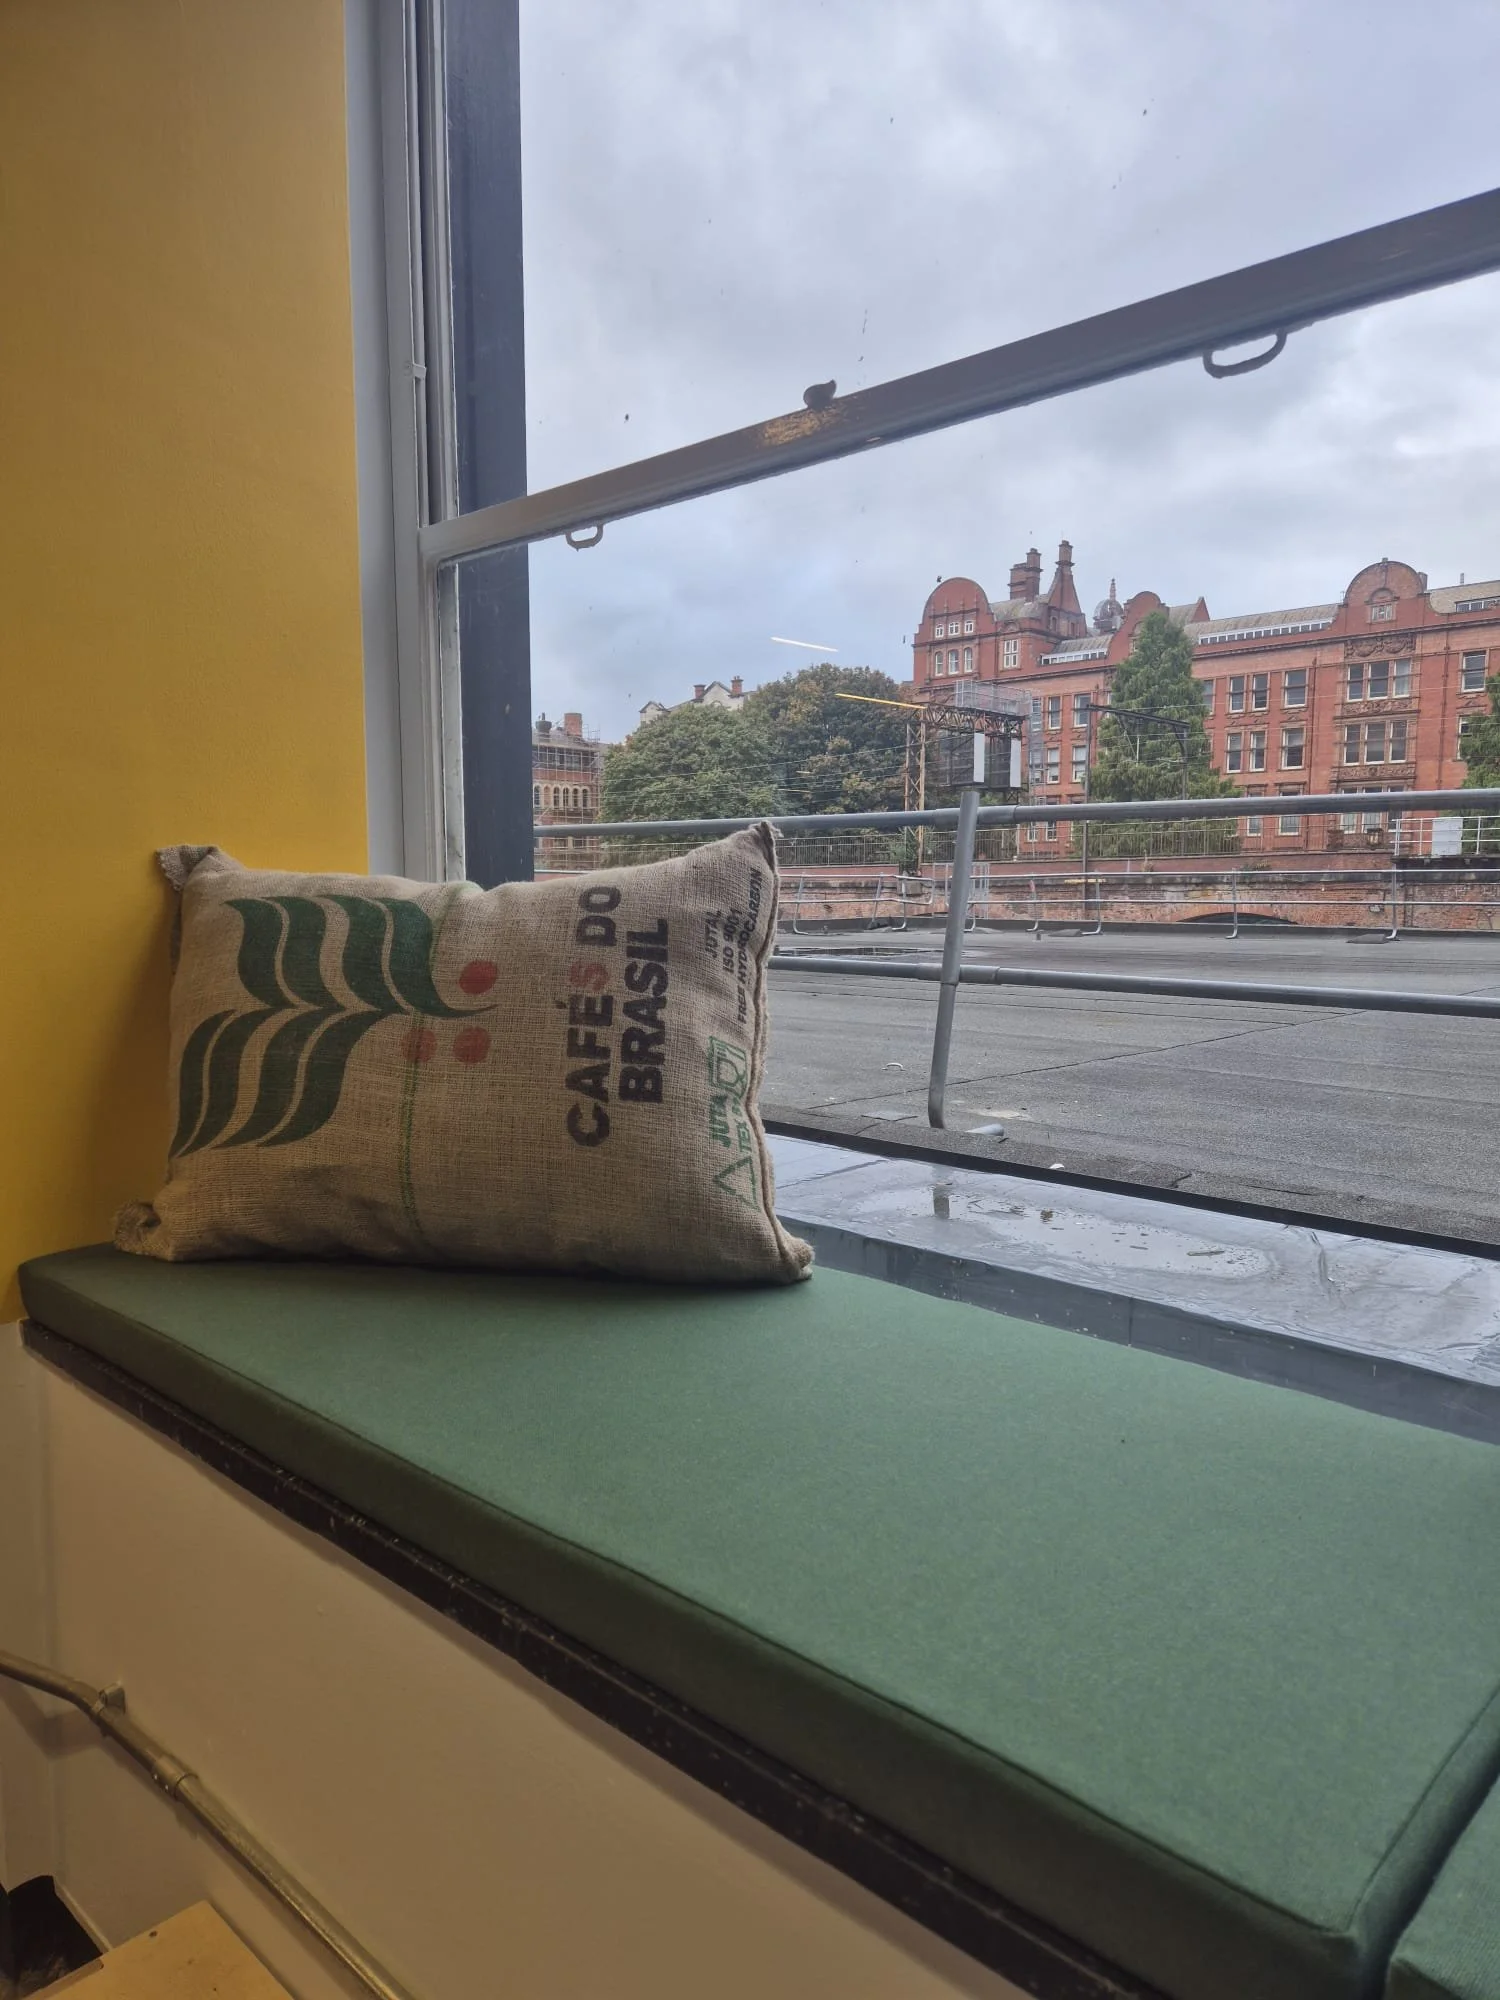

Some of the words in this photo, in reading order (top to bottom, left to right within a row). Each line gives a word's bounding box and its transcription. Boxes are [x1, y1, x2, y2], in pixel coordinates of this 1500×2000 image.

[576, 886, 621, 946] DO
[723, 908, 742, 943] 9001
[737, 867, 763, 984] HYDROCARBON
[723, 946, 735, 974] ISO
[618, 918, 668, 1103] BRASIL
[736, 987, 747, 1024] FREE
[555, 959, 614, 1148] CAFÉS
[708, 1095, 731, 1148] JUTA
